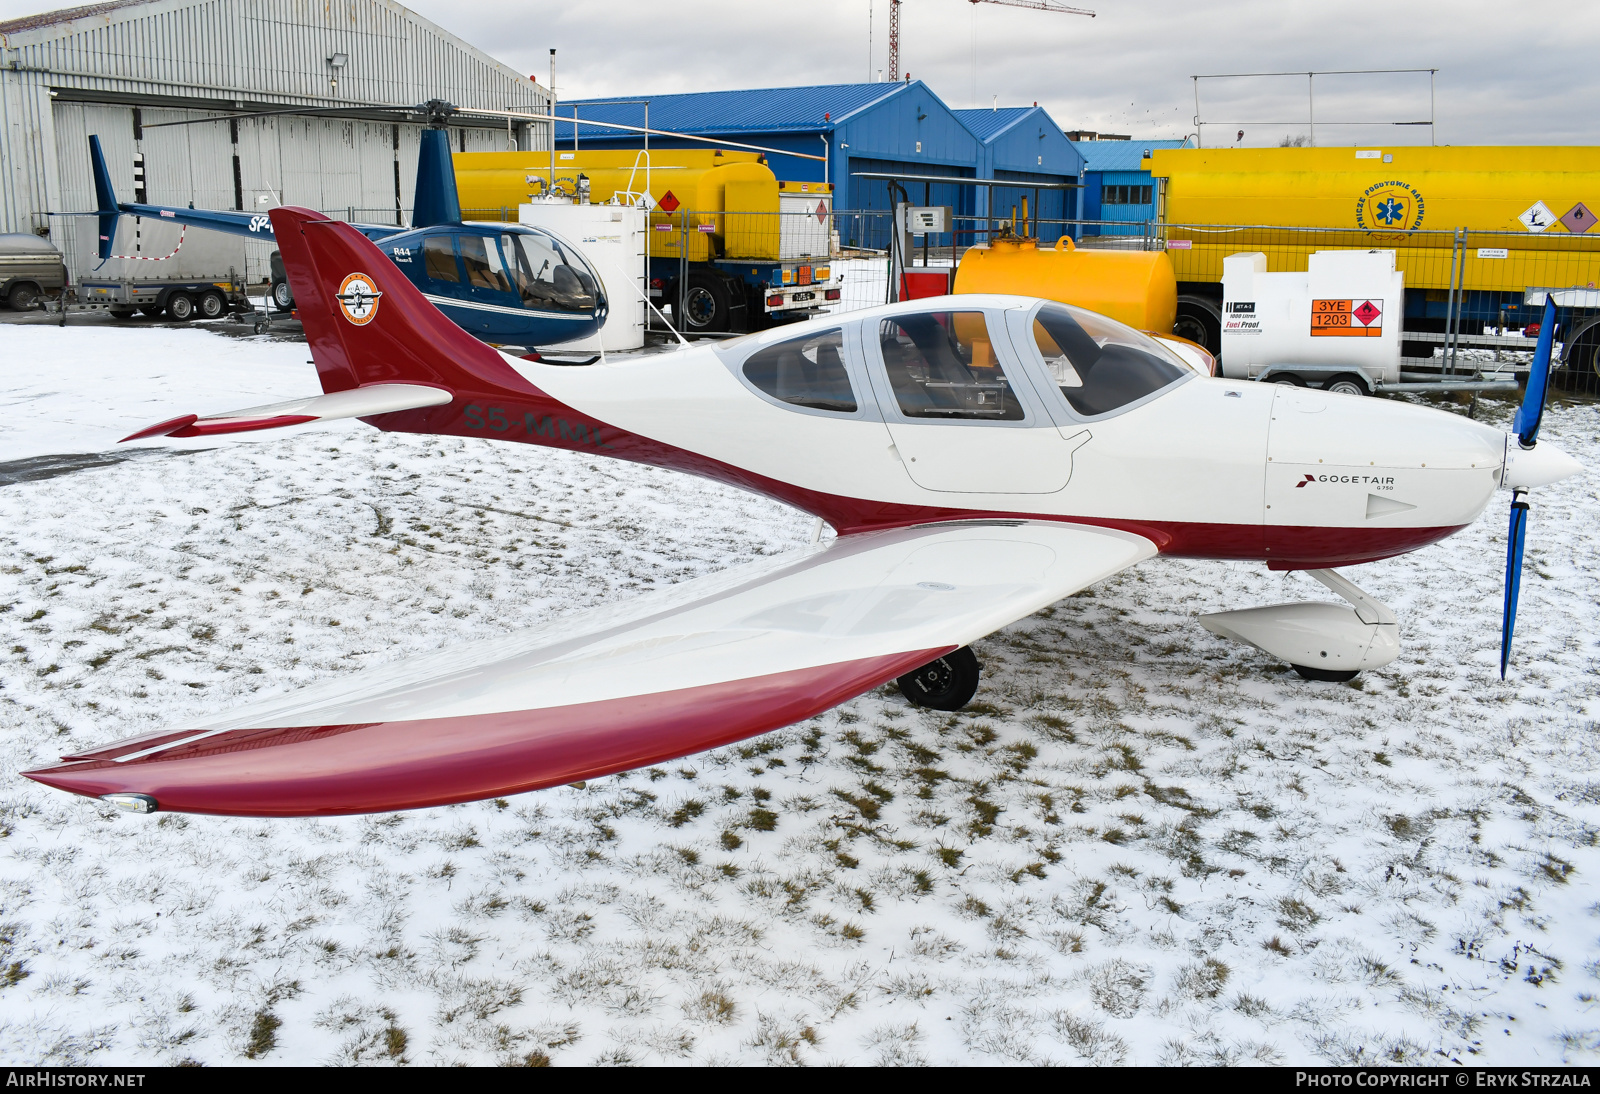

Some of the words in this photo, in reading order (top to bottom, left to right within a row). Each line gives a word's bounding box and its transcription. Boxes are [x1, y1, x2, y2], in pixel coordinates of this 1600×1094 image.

[393, 247, 411, 256] R44
[1319, 301, 1346, 311] 3YE
[1316, 314, 1347, 325] 1203
[463, 404, 615, 450] S5-MML
[1318, 474, 1395, 485] GOGETAIR
